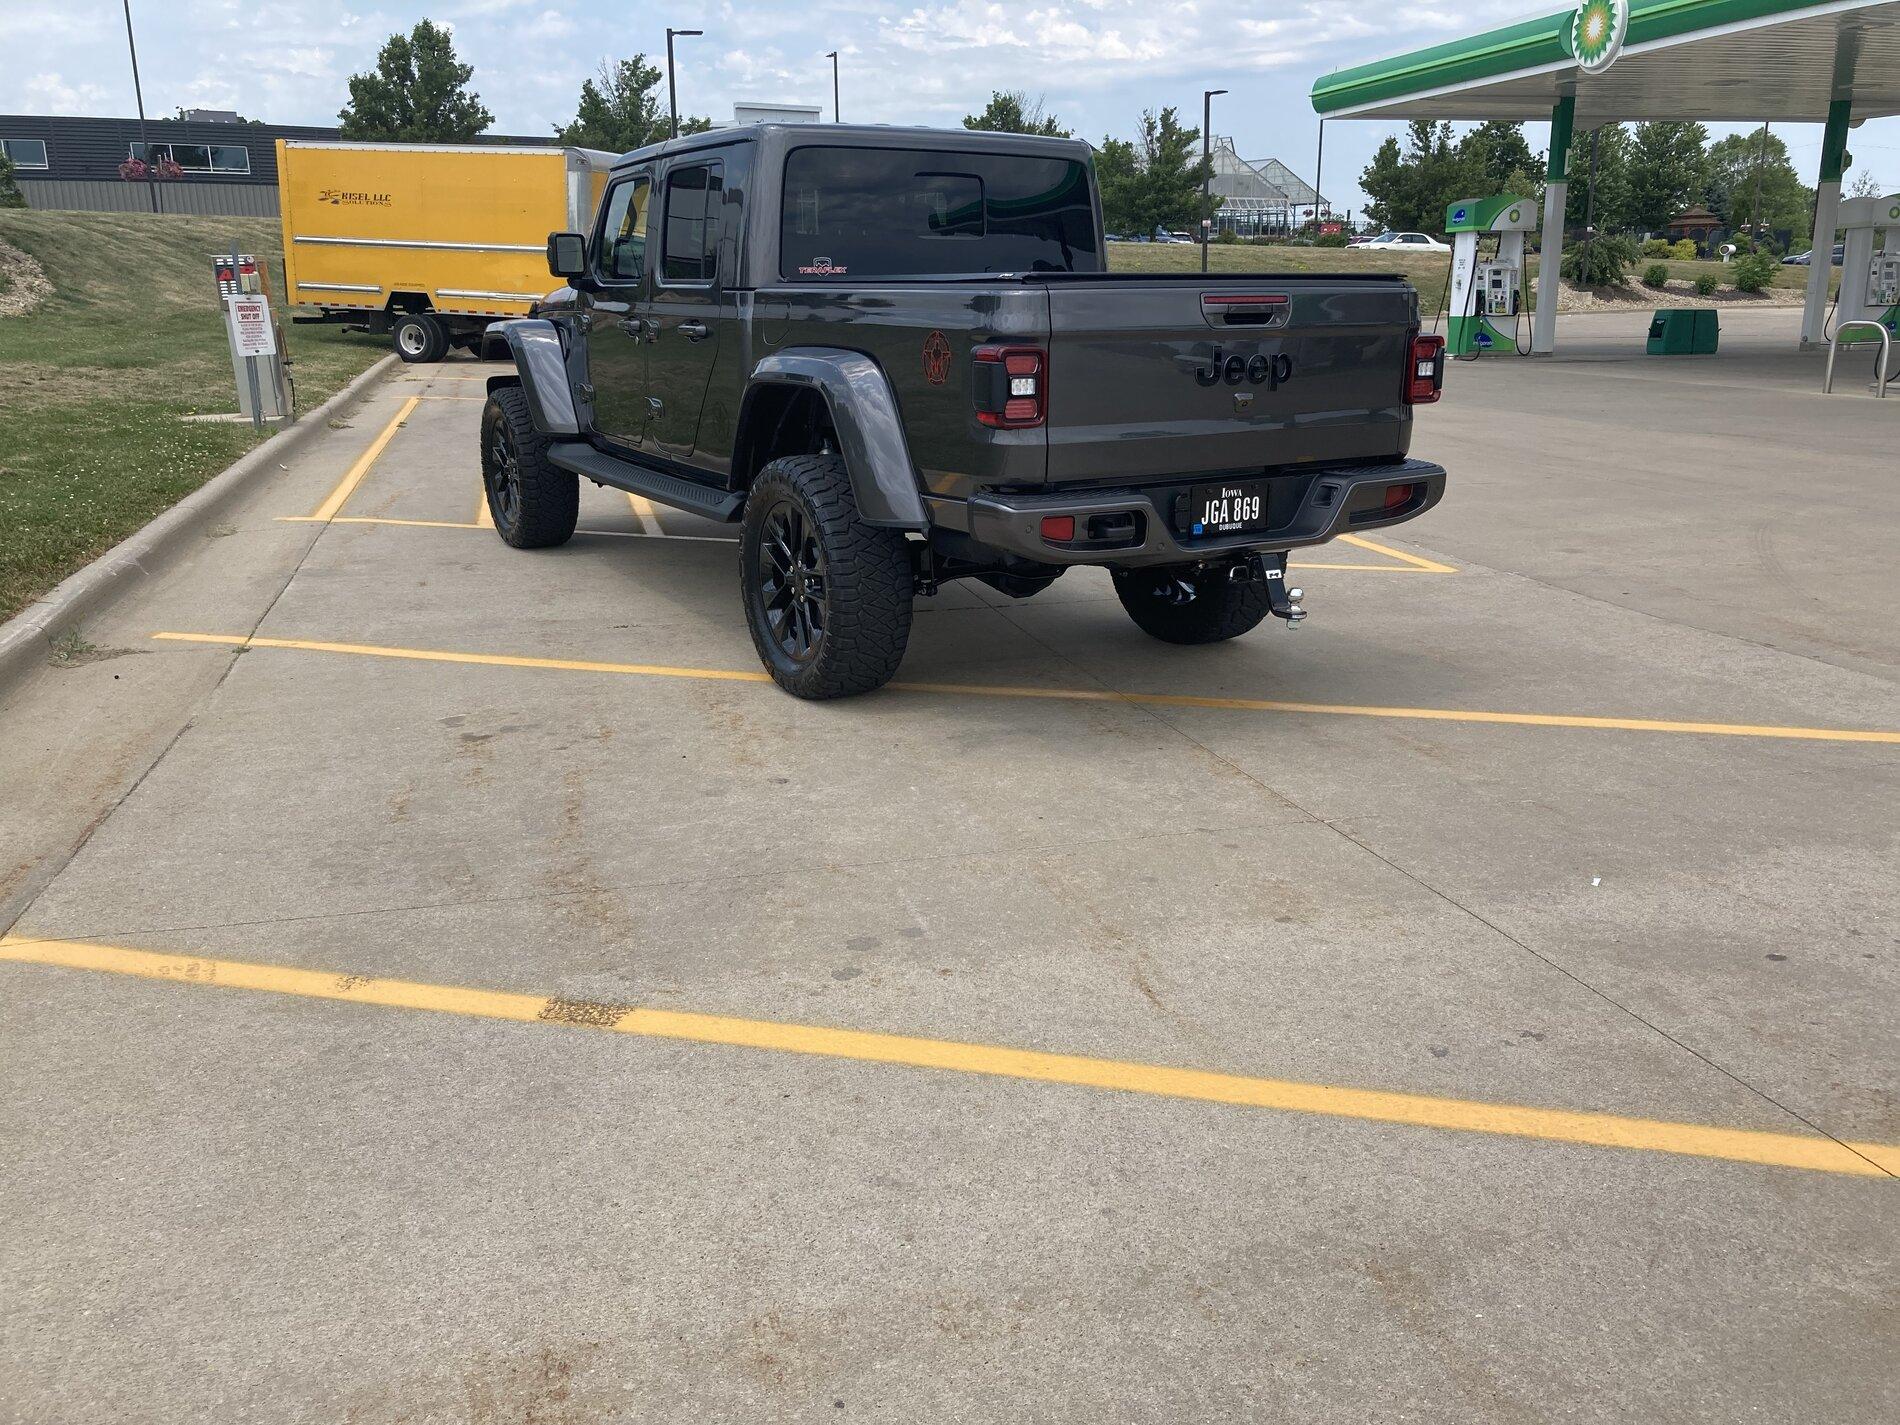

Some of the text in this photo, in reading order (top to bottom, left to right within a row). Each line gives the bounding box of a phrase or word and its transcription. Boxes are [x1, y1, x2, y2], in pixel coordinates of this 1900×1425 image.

[373, 193, 392, 202] LLC
[237, 305, 261, 313] EMERGENCY
[1195, 345, 1293, 392] Jeep
[1201, 496, 1260, 525] JGA 869
[1219, 522, 1243, 531] DUBUQUE
